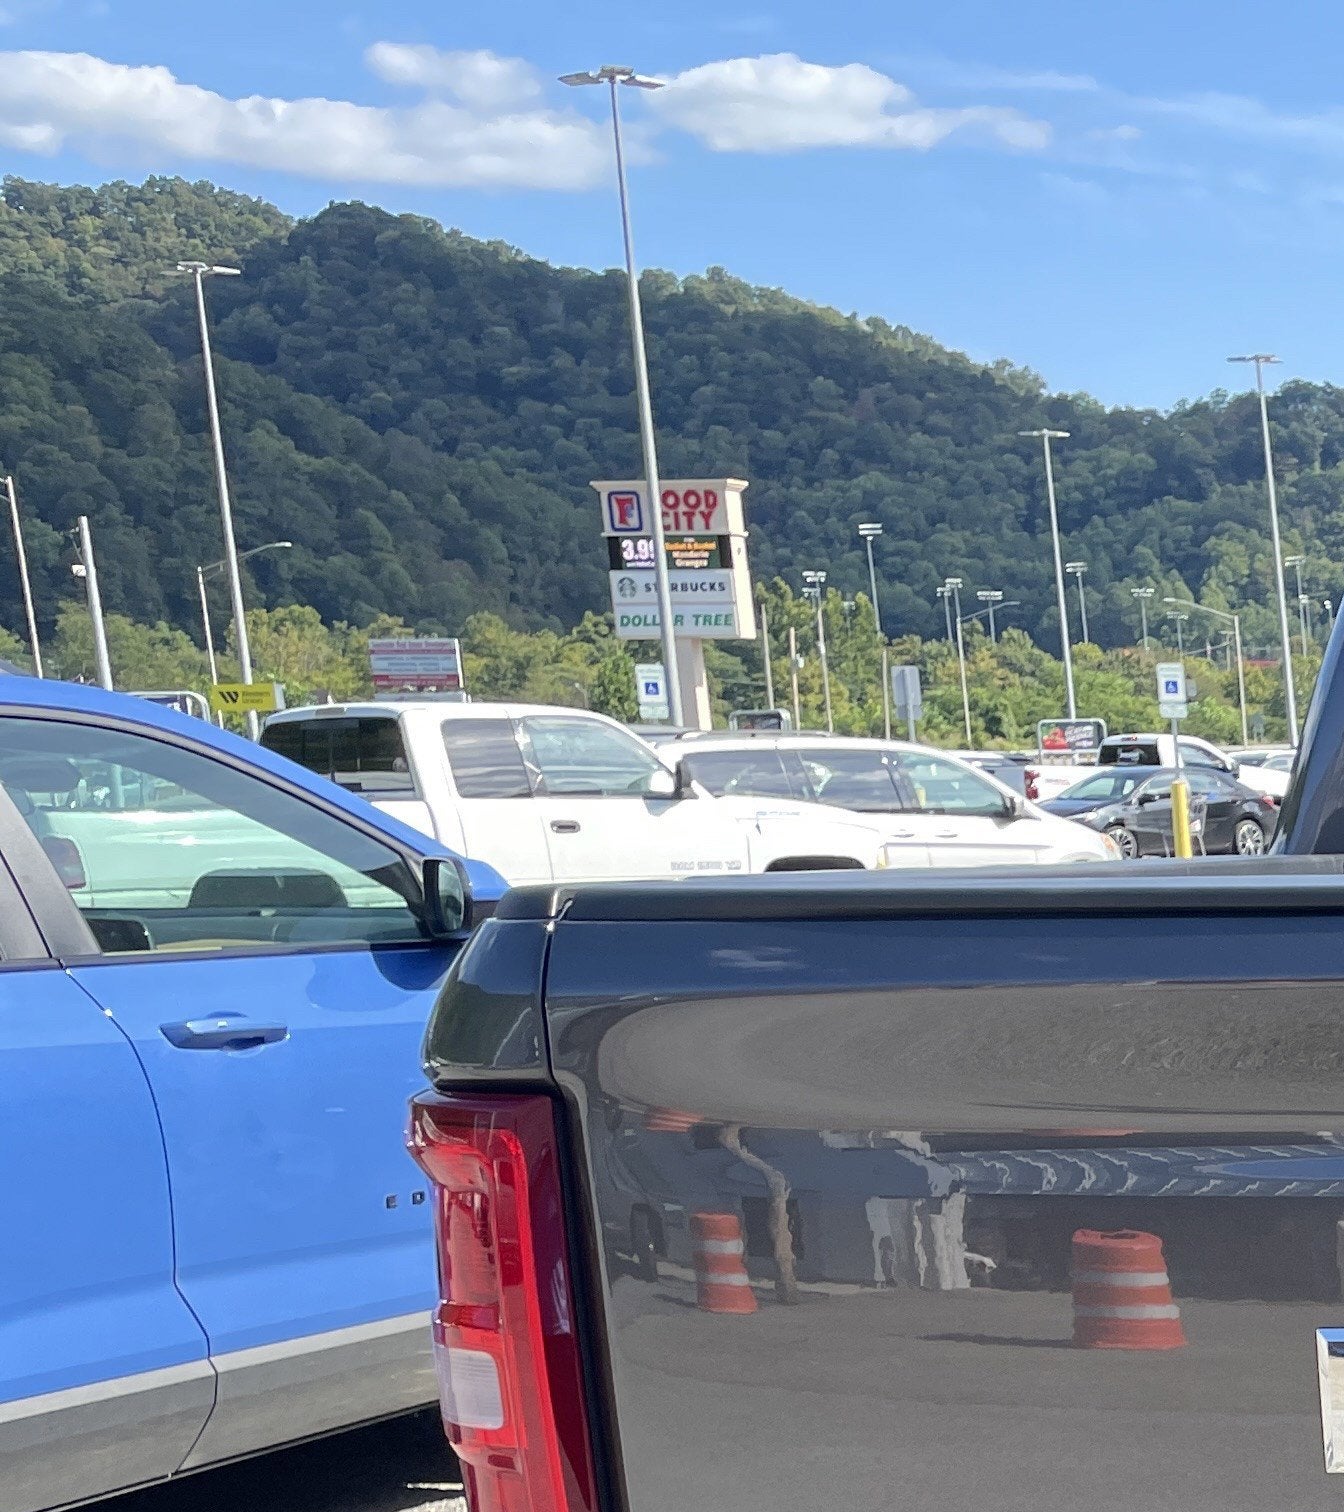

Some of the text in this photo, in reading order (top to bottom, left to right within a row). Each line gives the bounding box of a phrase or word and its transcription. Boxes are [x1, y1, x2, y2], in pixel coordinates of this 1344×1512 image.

[661, 489, 718, 510] OOD
[644, 581, 726, 592] STRBUCKS
[620, 613, 733, 627] DOLLR TREE
